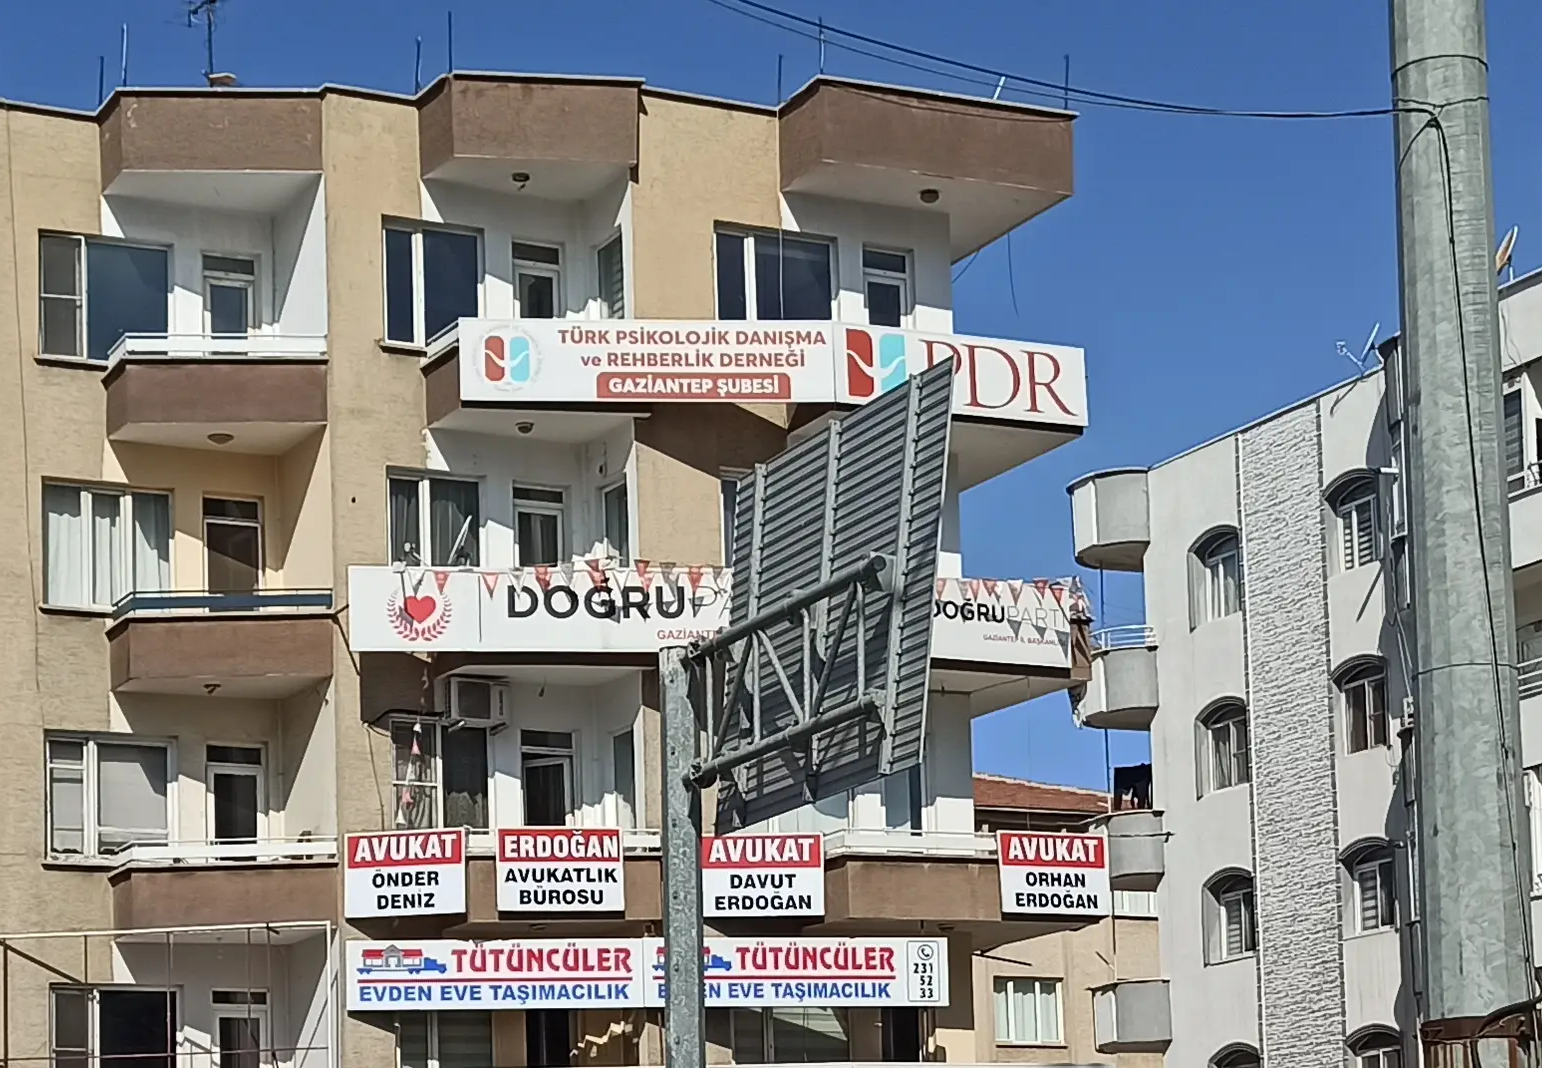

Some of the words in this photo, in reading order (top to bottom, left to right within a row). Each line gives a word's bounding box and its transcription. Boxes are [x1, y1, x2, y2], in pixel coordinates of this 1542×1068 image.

[558, 326, 610, 345] TÜRK
[616, 327, 729, 345] PSİKOLOJİK
[735, 330, 826, 348] DANIŞMA
[581, 355, 601, 367] ve
[607, 349, 713, 367] REHBERLİK
[719, 349, 805, 368] DERNEĞİ
[608, 374, 713, 394] GAZİANTEP
[716, 374, 779, 397] ŞUBESİ
[657, 628, 720, 641] GAZİANT
[354, 833, 459, 863] AVUKAT
[504, 830, 618, 859] ERDOĞAN
[708, 838, 814, 863] AVUKAT
[1008, 837, 1098, 863] AVUKAT
[372, 869, 439, 888] ÖNDER
[505, 868, 617, 884] AVUKATLIK
[730, 874, 797, 889] DAVUT
[1025, 872, 1086, 888] ORHAN
[377, 889, 436, 910] DENİZ
[519, 885, 604, 905] BÜROSU
[715, 891, 812, 911] ERDOĞAN
[1015, 890, 1098, 910] ERDOĞAN
[451, 943, 633, 974] TÜTÜNCÜLER
[735, 942, 895, 972] TÜTÜNCÜLER
[913, 963, 934, 974] 231
[919, 976, 933, 986] 52
[359, 985, 432, 1002] EVDEN
[440, 984, 483, 1001] EVE
[489, 984, 630, 1005] TAŞIMACILIK
[728, 983, 764, 998] EVE
[771, 983, 891, 1002] TAŞIMACILIK
[919, 988, 934, 999] 33
